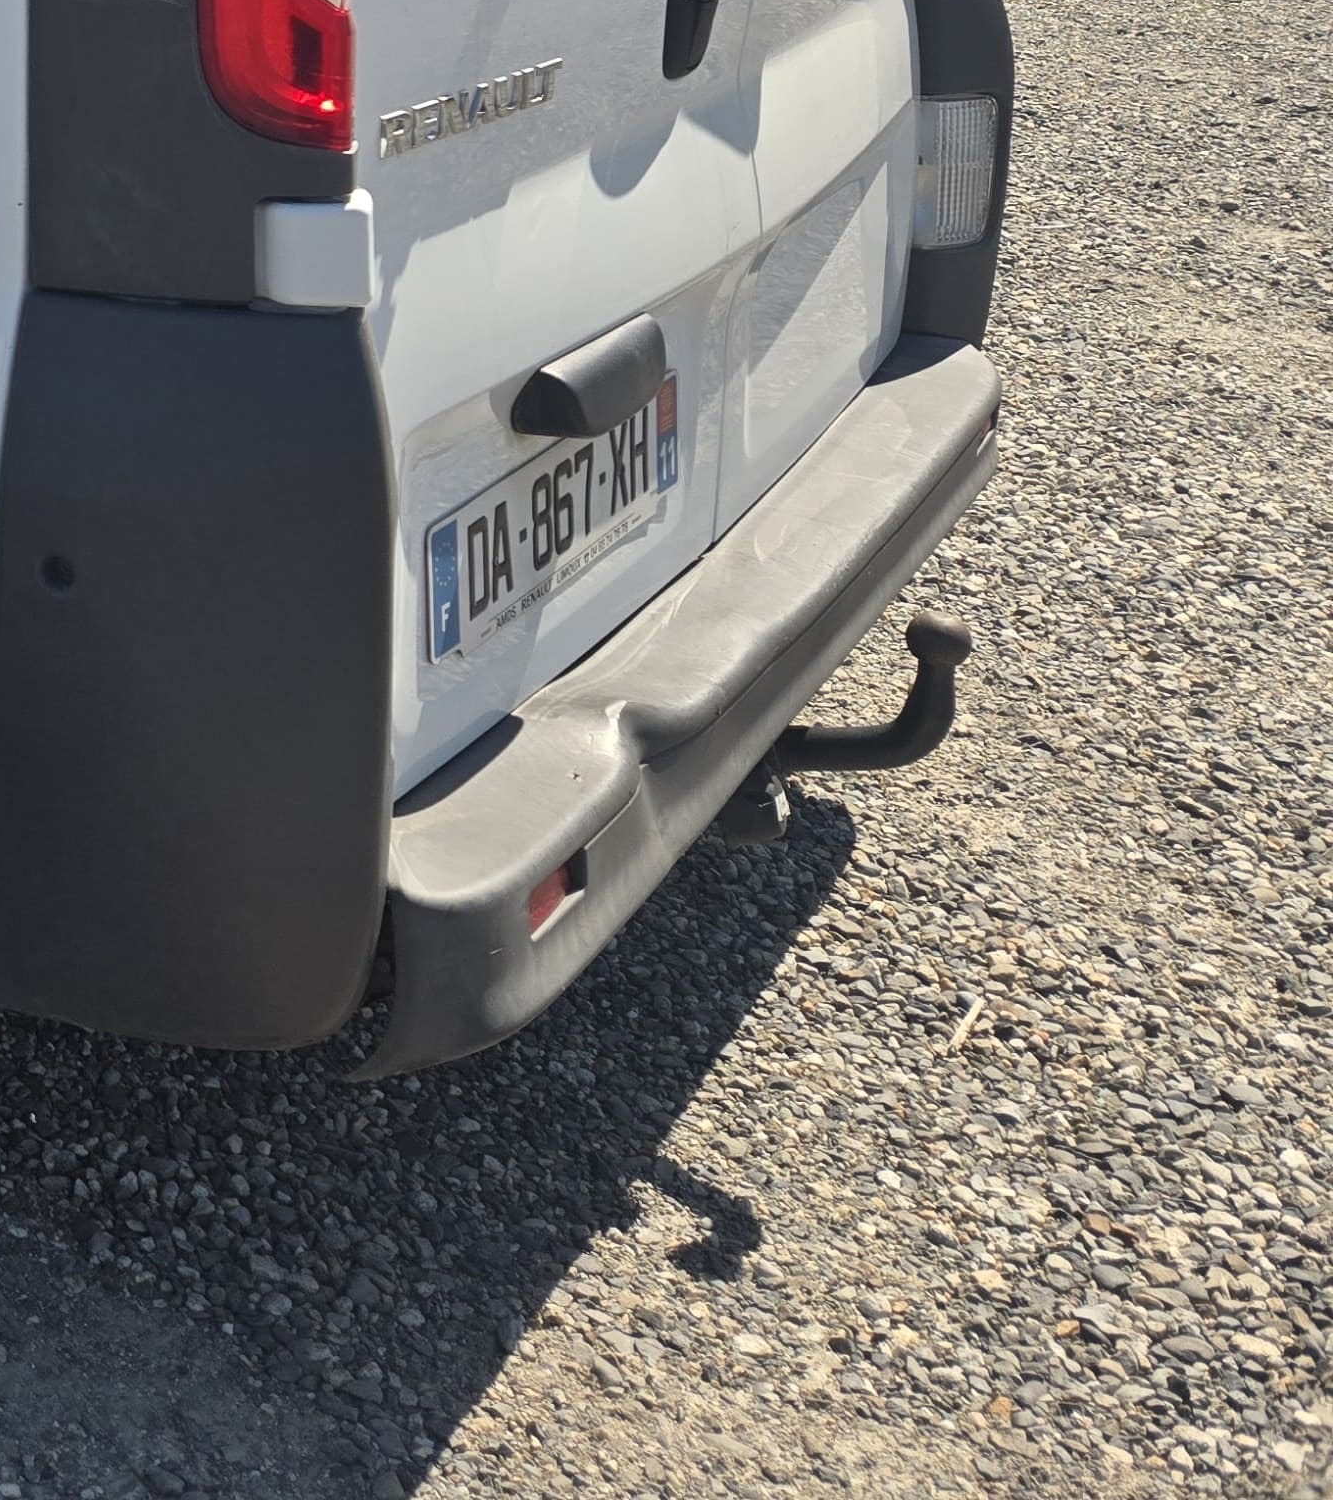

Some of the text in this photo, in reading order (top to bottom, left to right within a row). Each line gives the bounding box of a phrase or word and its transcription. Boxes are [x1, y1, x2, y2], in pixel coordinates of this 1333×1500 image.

[379, 57, 563, 159] RENAULT
[659, 436, 675, 481] 11
[468, 405, 649, 621] DA-867-XH
[440, 602, 451, 633] F
[520, 578, 553, 613] RENAULT
